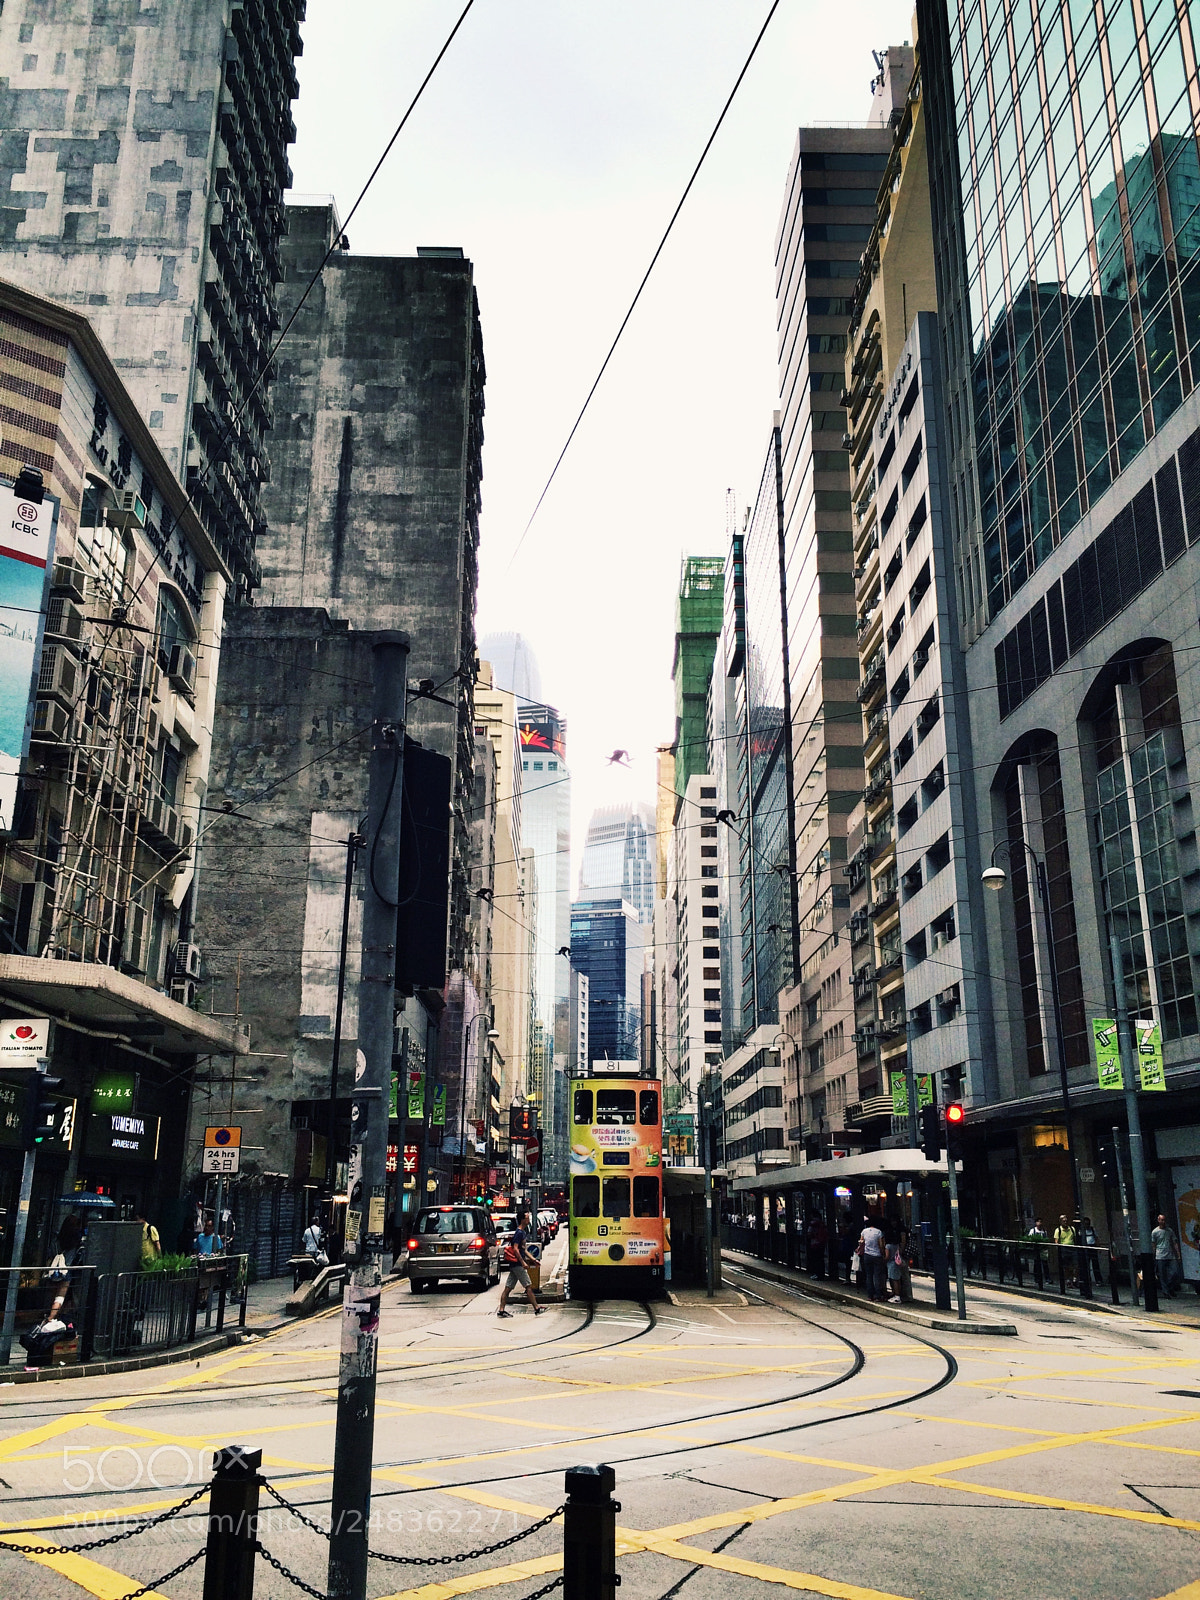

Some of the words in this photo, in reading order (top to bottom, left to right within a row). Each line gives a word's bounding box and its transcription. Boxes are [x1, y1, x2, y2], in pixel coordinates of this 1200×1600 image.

[89, 429, 109, 467] KAI
[109, 459, 127, 490] TAK
[11, 520, 40, 537] ICBC
[606, 1060, 620, 1071] 81
[111, 1115, 145, 1135] YUMEMIYA
[208, 1150, 219, 1158] 24
[221, 1150, 235, 1158] hrs
[210, 1159, 232, 1171] 全日
